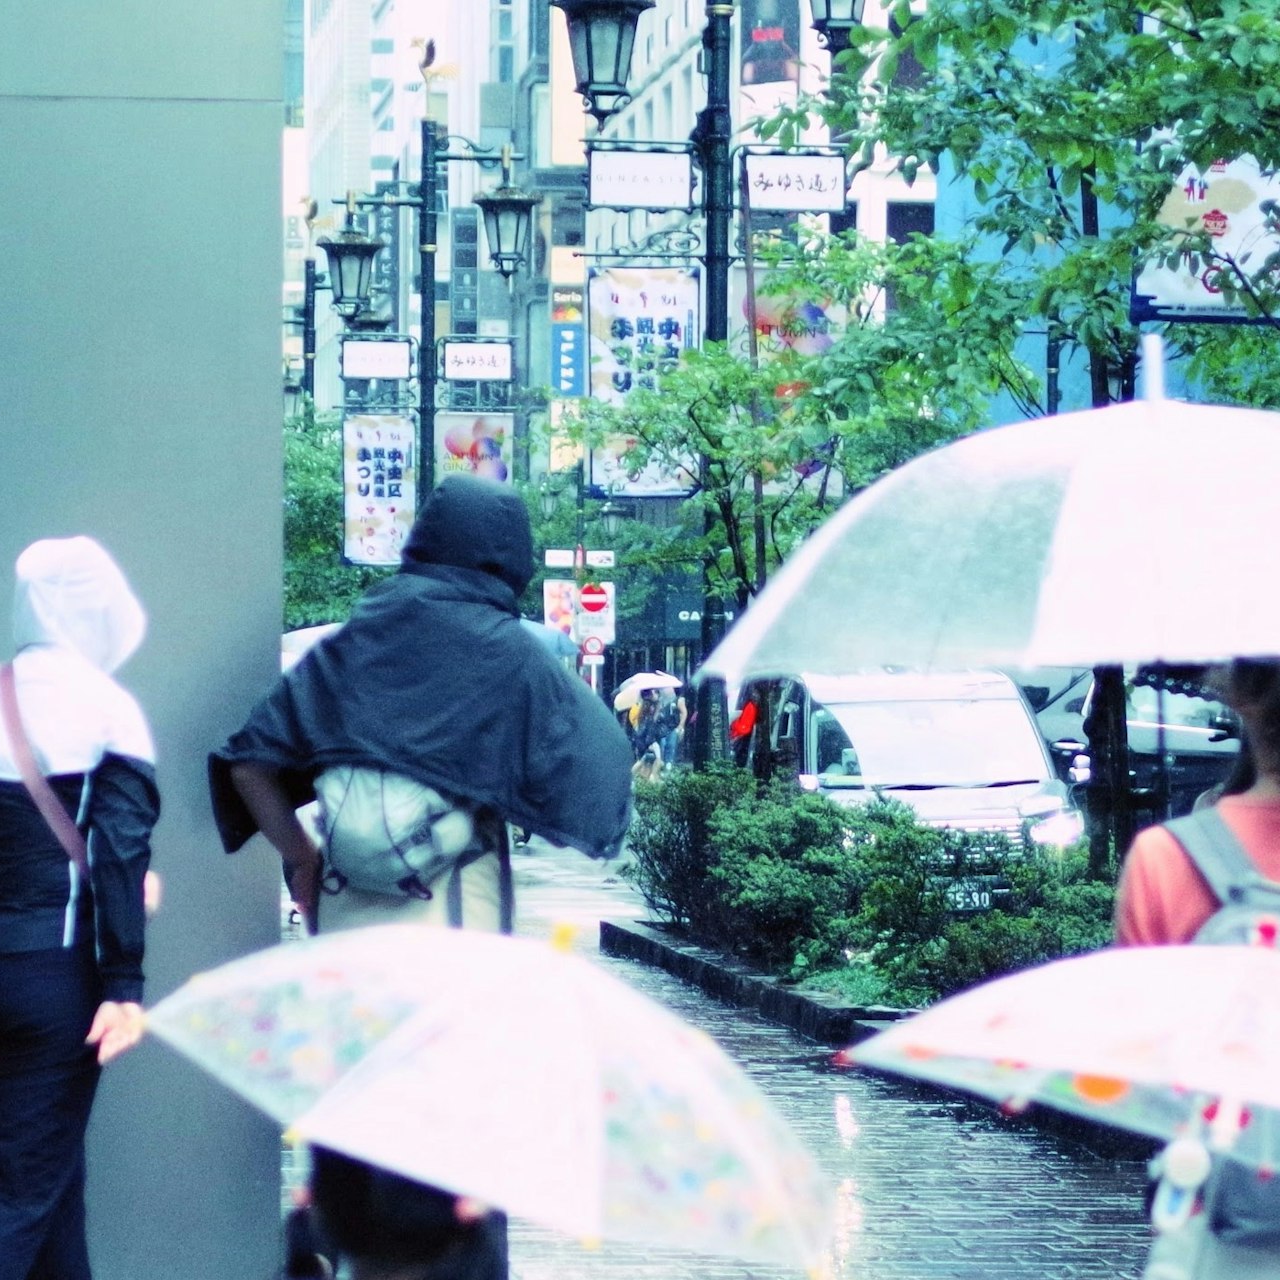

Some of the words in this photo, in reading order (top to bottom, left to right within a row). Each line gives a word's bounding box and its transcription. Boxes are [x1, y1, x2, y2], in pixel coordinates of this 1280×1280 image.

[753, 172, 838, 193] みゆき通り
[611, 317, 633, 393] まり
[740, 339, 793, 353] GNZA
[357, 447, 370, 497] まつり
[387, 448, 402, 498] 中央区
[678, 610, 734, 621] CAN
